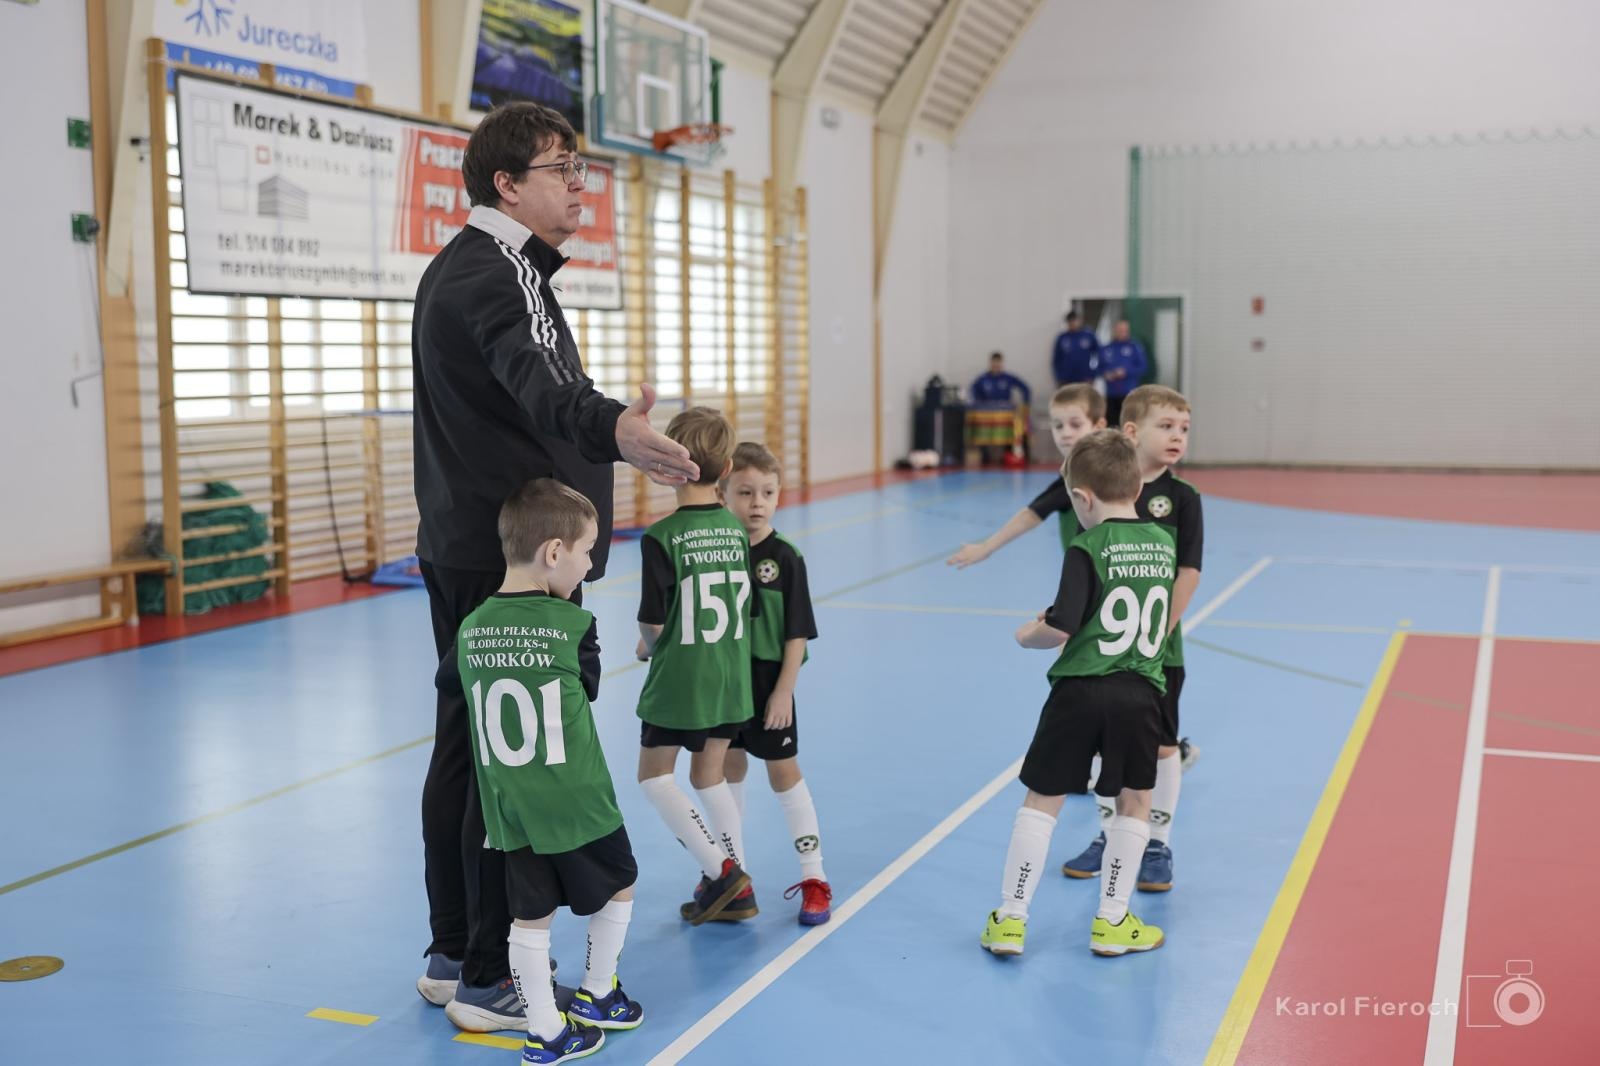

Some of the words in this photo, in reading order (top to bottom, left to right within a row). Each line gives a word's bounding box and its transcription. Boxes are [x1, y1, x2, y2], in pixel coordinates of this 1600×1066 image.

[238, 14, 338, 61] Jureczka
[233, 103, 300, 137] Marek
[308, 117, 321, 140] &
[329, 120, 393, 152] Dariusz
[671, 529, 714, 545] AKADEMIA
[680, 570, 750, 645] 157
[1098, 586, 1169, 659] 90
[467, 639, 513, 650] MŁODEGO
[516, 639, 549, 649] LKS-u
[503, 626, 569, 641] PIŁKARSKA
[466, 649, 556, 669] TWORKÓW
[471, 677, 567, 767] 101
